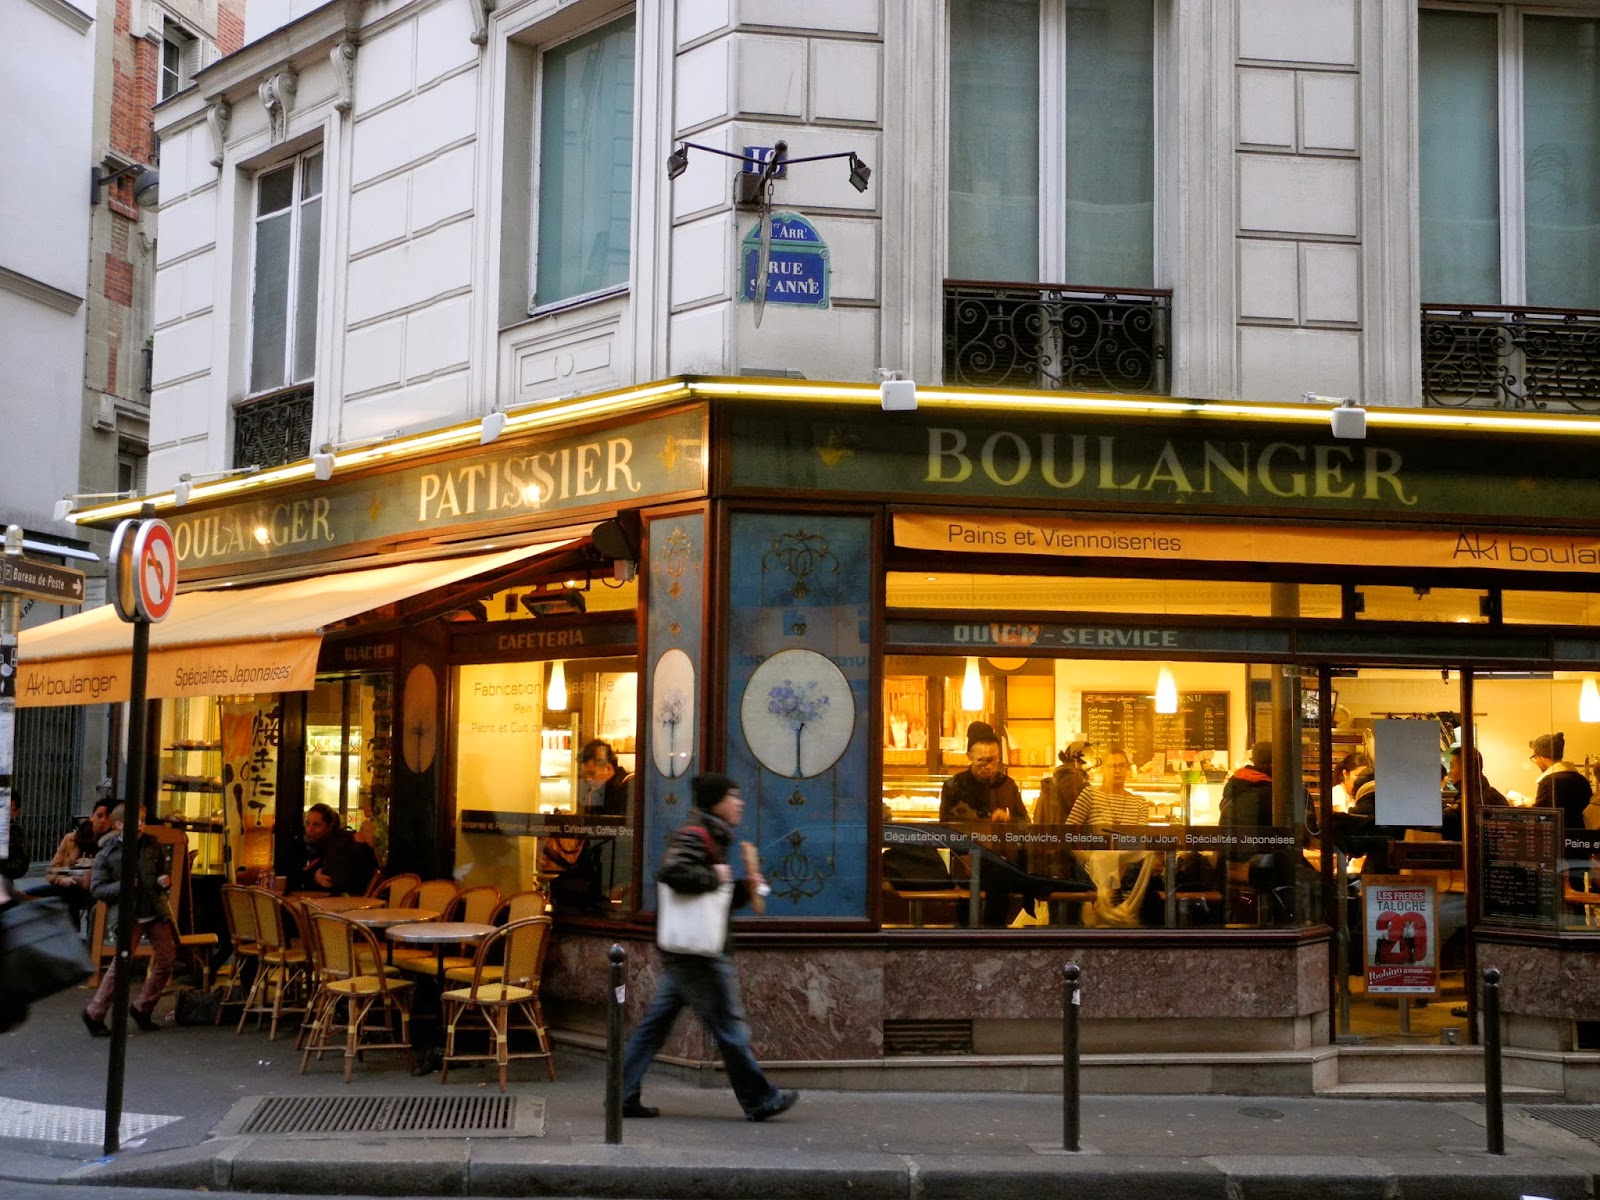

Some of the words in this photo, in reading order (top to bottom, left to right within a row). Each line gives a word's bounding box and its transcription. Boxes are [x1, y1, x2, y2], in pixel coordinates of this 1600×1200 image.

[768, 262, 803, 275] RUE
[774, 280, 820, 295] ANNE
[923, 427, 1418, 506] BOULANGER
[418, 437, 641, 522] PATISSIER
[175, 496, 335, 562] OULANGER
[948, 524, 1007, 545] Pains
[1014, 529, 1036, 546] et
[1041, 529, 1182, 551] Viennoiseries
[1453, 533, 1499, 561] Aki
[1509, 540, 1600, 565] boula
[13, 567, 37, 585] Bureau
[38, 573, 46, 587] de
[47, 575, 65, 590] Poste
[499, 629, 585, 650] CAFETERIA
[953, 624, 1039, 644] QUICK
[1061, 628, 1178, 646] SERVICE
[344, 643, 395, 661] GLACIER
[175, 663, 228, 687] Spécialités
[229, 662, 292, 687] Japonaises
[47, 673, 118, 699] boulanger
[474, 681, 541, 697] Fabrication
[1180, 694, 1202, 703] ENU
[596, 824, 618, 836] Coffee
[884, 831, 946, 845] Dégustation
[950, 833, 967, 843] sur
[971, 832, 1001, 844] Place,
[1005, 832, 1061, 845] Sandwichs,
[1065, 833, 1108, 845] Salades,
[1111, 833, 1137, 844] Plats
[1140, 834, 1153, 844] du
[1185, 833, 1238, 846] Spécialités
[1240, 834, 1295, 847] Japonaises
[1564, 838, 1591, 849] Pains
[1593, 840, 1600, 849] e
[1377, 891, 1393, 900] LES
[1376, 900, 1426, 911] TALOCHE
